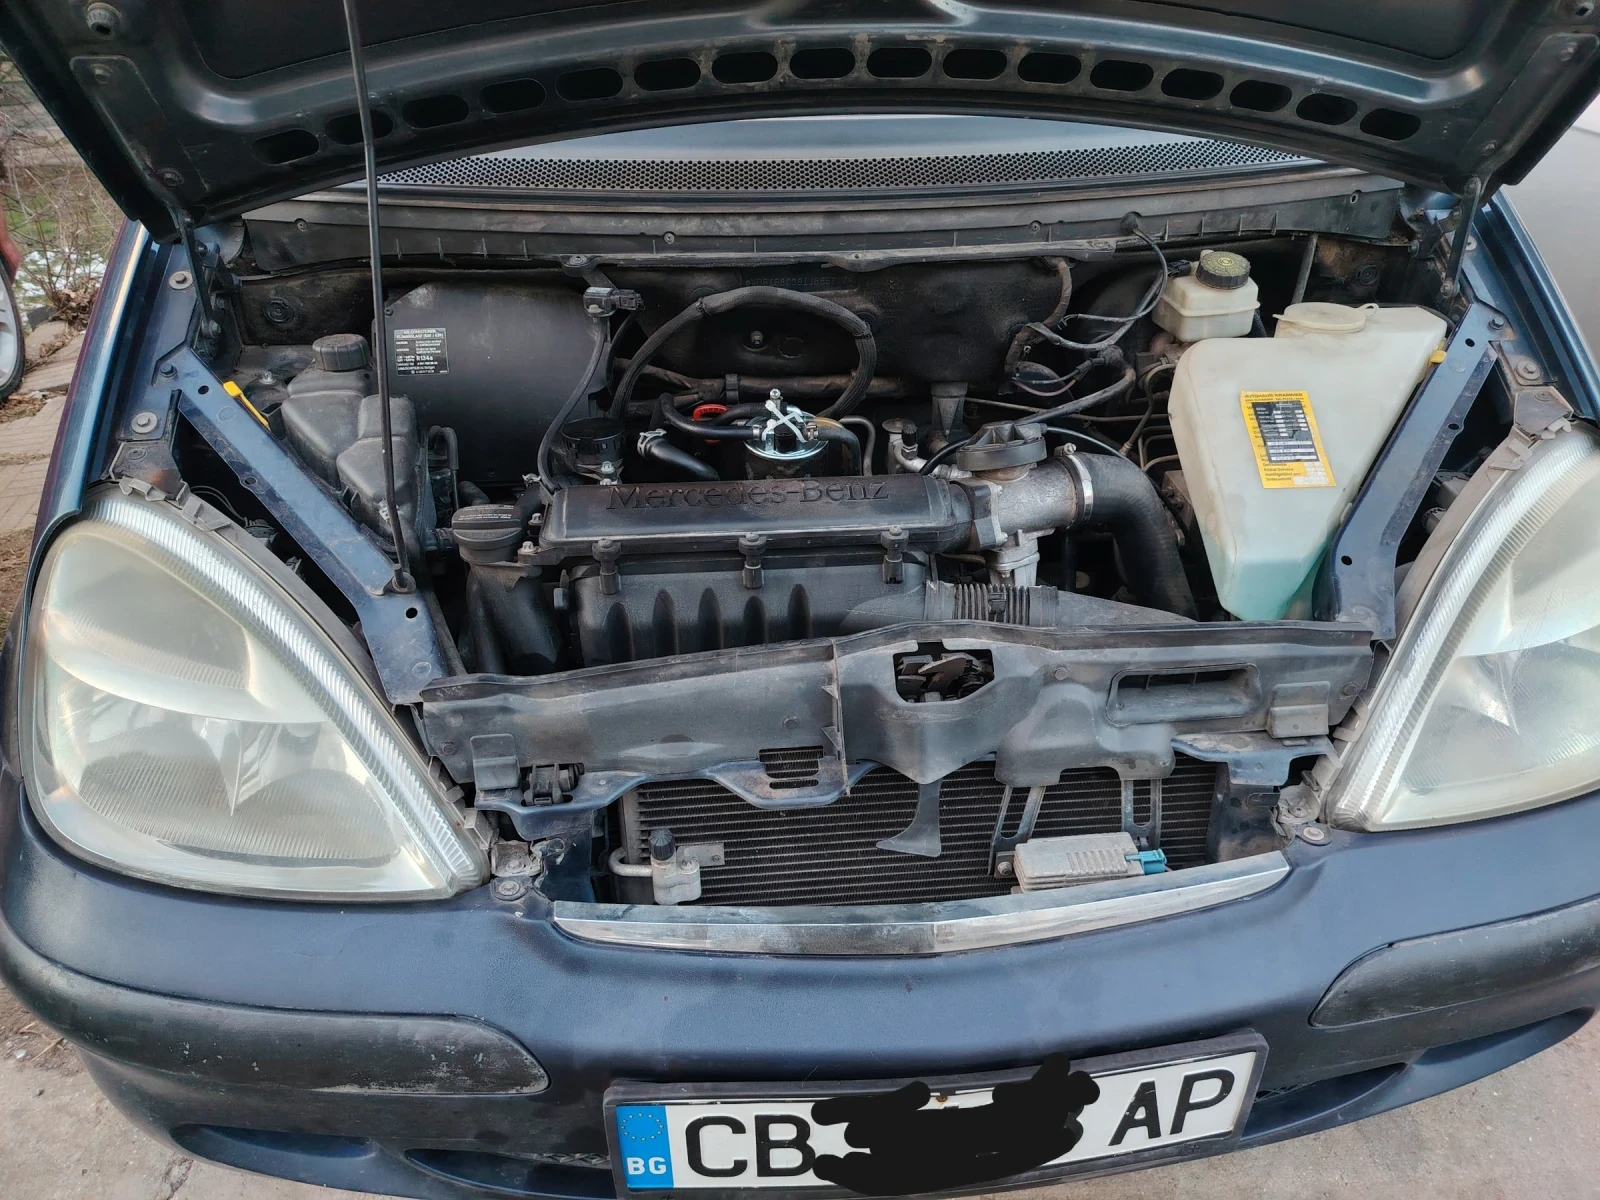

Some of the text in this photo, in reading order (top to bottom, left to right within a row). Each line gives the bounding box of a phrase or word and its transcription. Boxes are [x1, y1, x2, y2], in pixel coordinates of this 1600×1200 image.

[606, 479, 889, 509] Mercedes-Benz
[685, 1114, 816, 1177] CB
[1108, 1069, 1235, 1146] AP
[626, 1157, 667, 1175] BG
